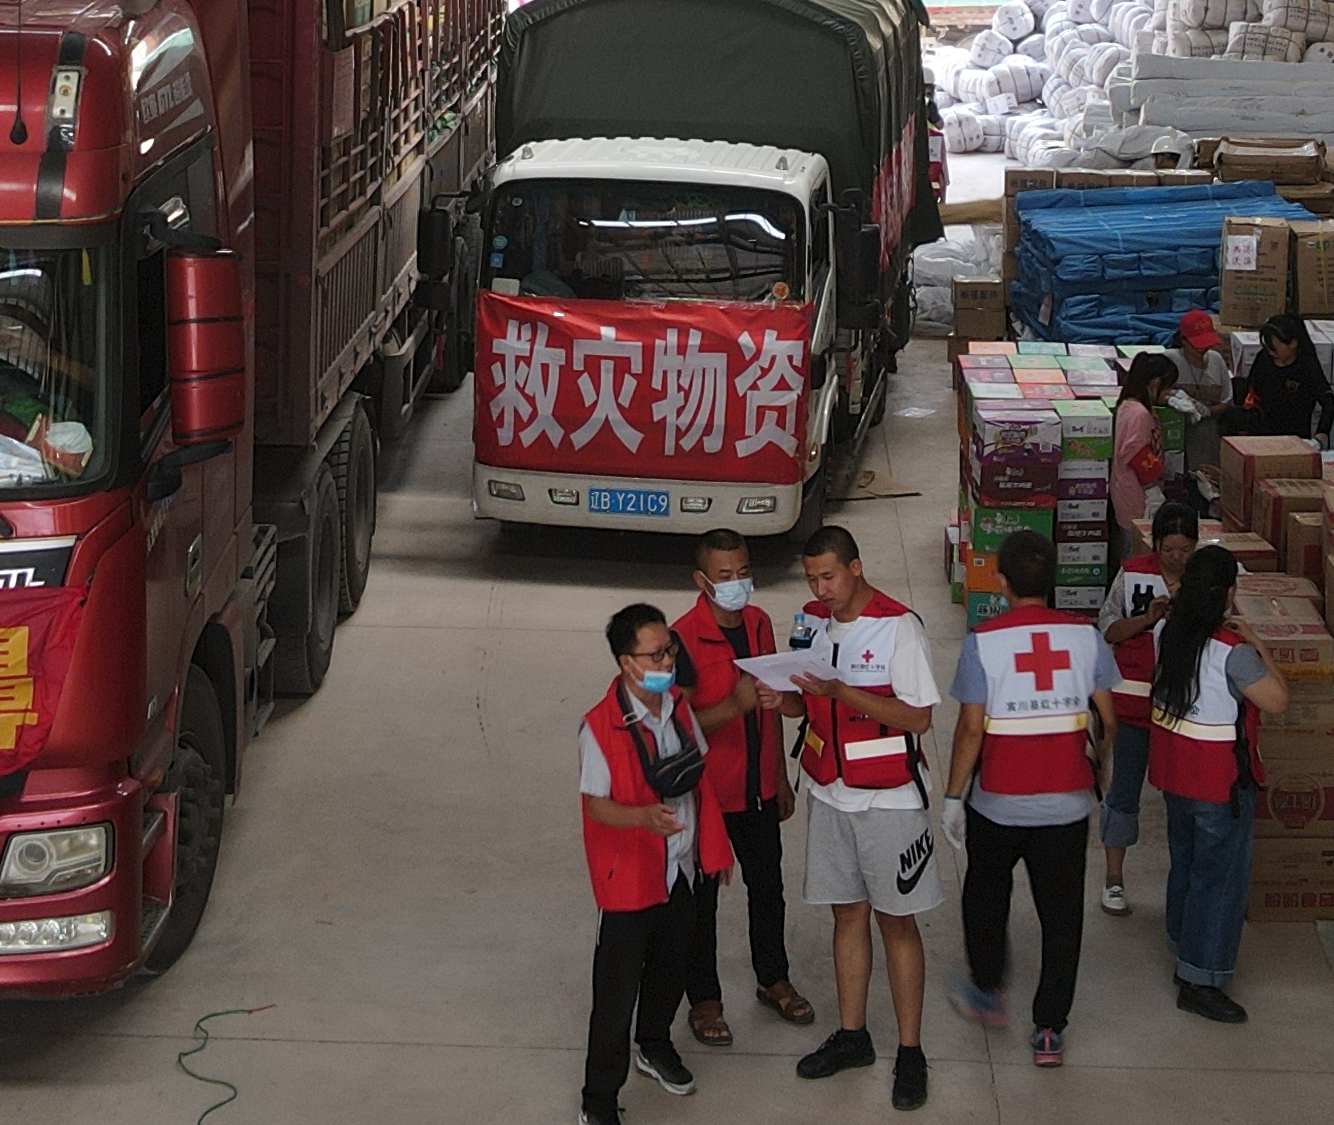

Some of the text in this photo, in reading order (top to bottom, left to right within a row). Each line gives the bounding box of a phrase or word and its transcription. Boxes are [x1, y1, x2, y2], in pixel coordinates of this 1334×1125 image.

[489, 319, 805, 459] 救灾物资
[899, 827, 934, 874] NIKE
